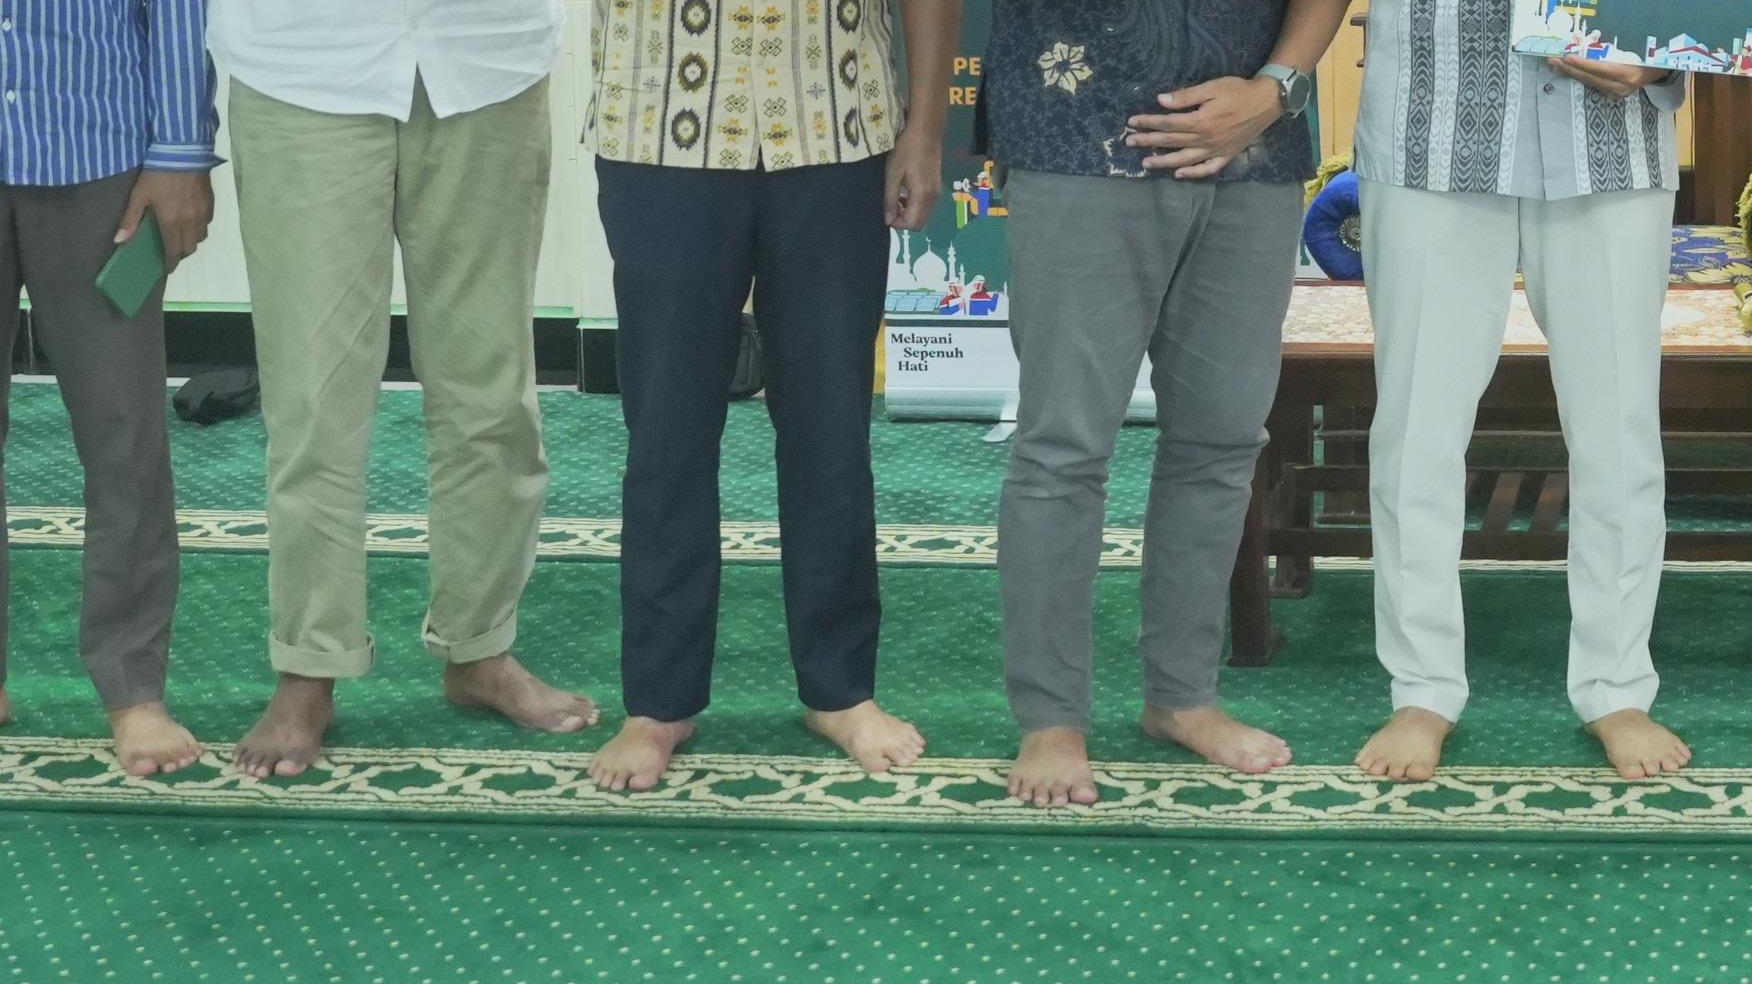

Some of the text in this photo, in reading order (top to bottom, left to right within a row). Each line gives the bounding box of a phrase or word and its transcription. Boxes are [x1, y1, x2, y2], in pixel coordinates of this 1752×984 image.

[890, 332, 953, 347] Melayani
[903, 346, 964, 361] Sepenuh
[897, 360, 929, 372] Hati
